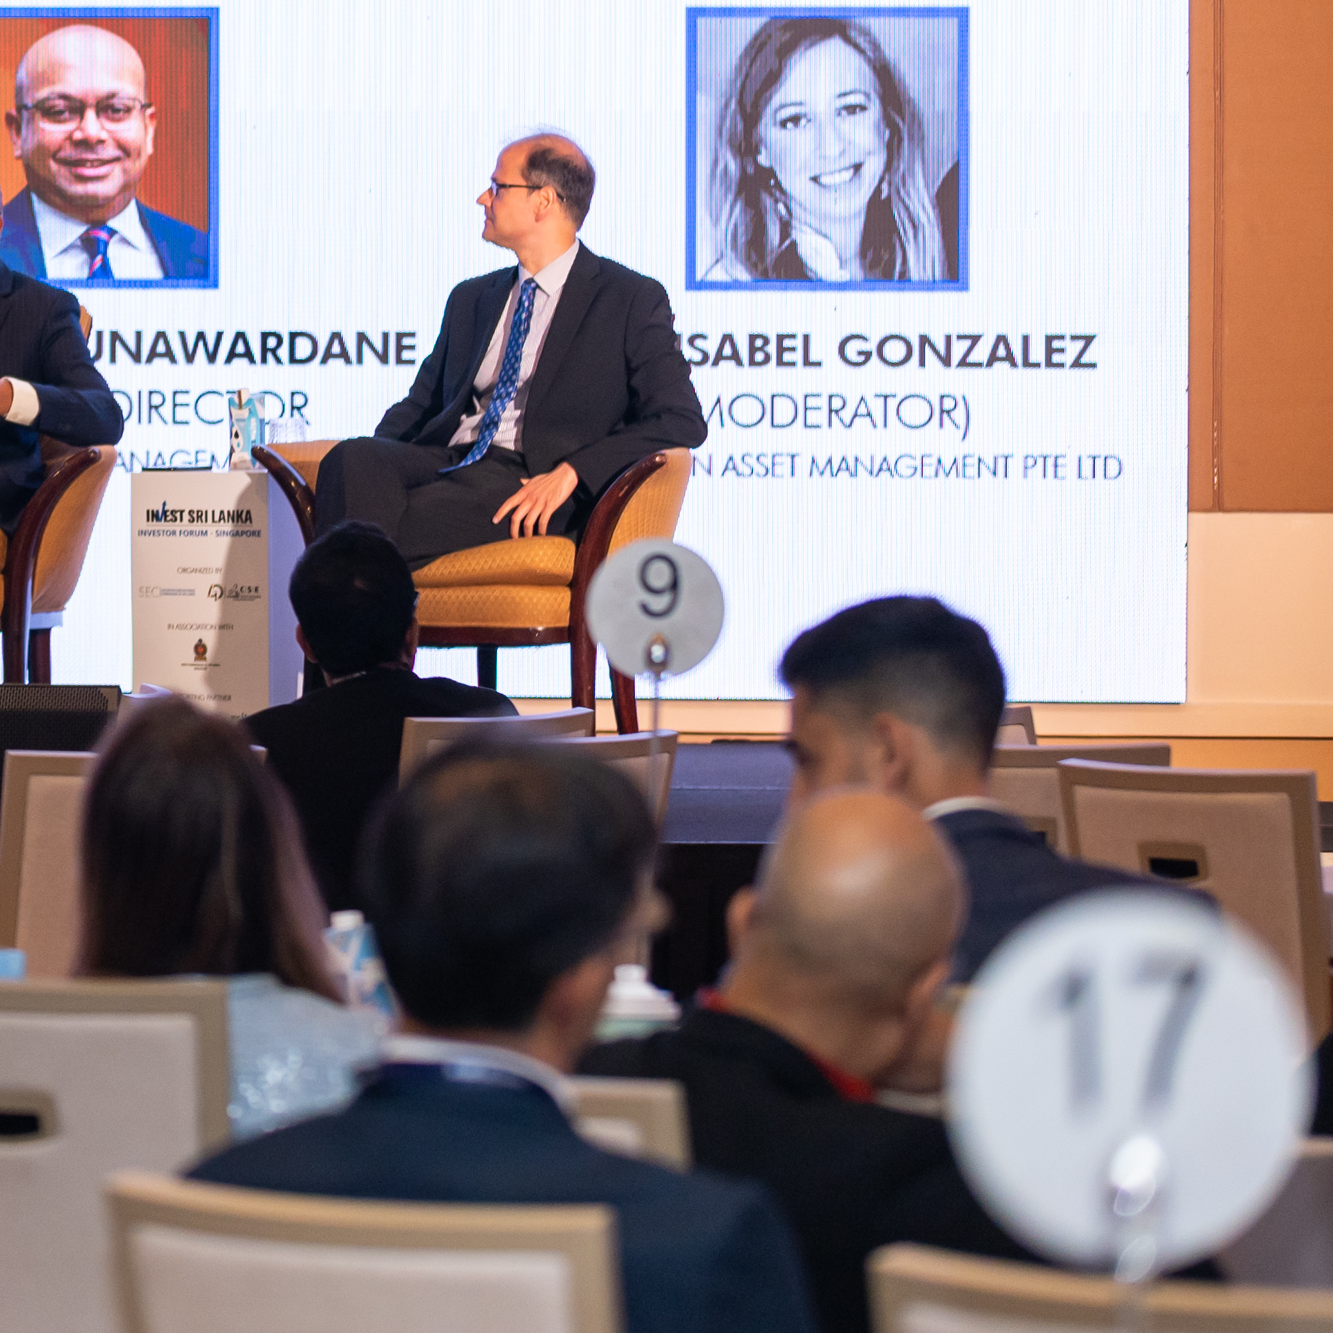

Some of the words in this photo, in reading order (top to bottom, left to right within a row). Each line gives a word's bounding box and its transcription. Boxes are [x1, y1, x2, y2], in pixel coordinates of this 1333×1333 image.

[91, 330, 417, 365] UNAWARDANE
[838, 334, 1098, 368] GONZALEZ
[110, 389, 311, 426] DIRECOR
[706, 392, 970, 442] MODERATOR)
[721, 453, 800, 478] ASSET
[809, 453, 1014, 479] MANAGEMENT
[1023, 453, 1067, 479] PTE
[1077, 454, 1123, 480] LTD
[146, 505, 185, 524] INVEST
[188, 509, 209, 524] SRI
[211, 509, 253, 525] LANKA
[137, 528, 177, 537] INVESTOR
[179, 529, 209, 538] FORUM
[215, 529, 262, 538] SINGAPORE
[177, 567, 213, 575] ORGANIZED
[638, 552, 680, 620] 9
[175, 623, 218, 631] ASSOCIATION
[1041, 950, 1208, 1120] 17
